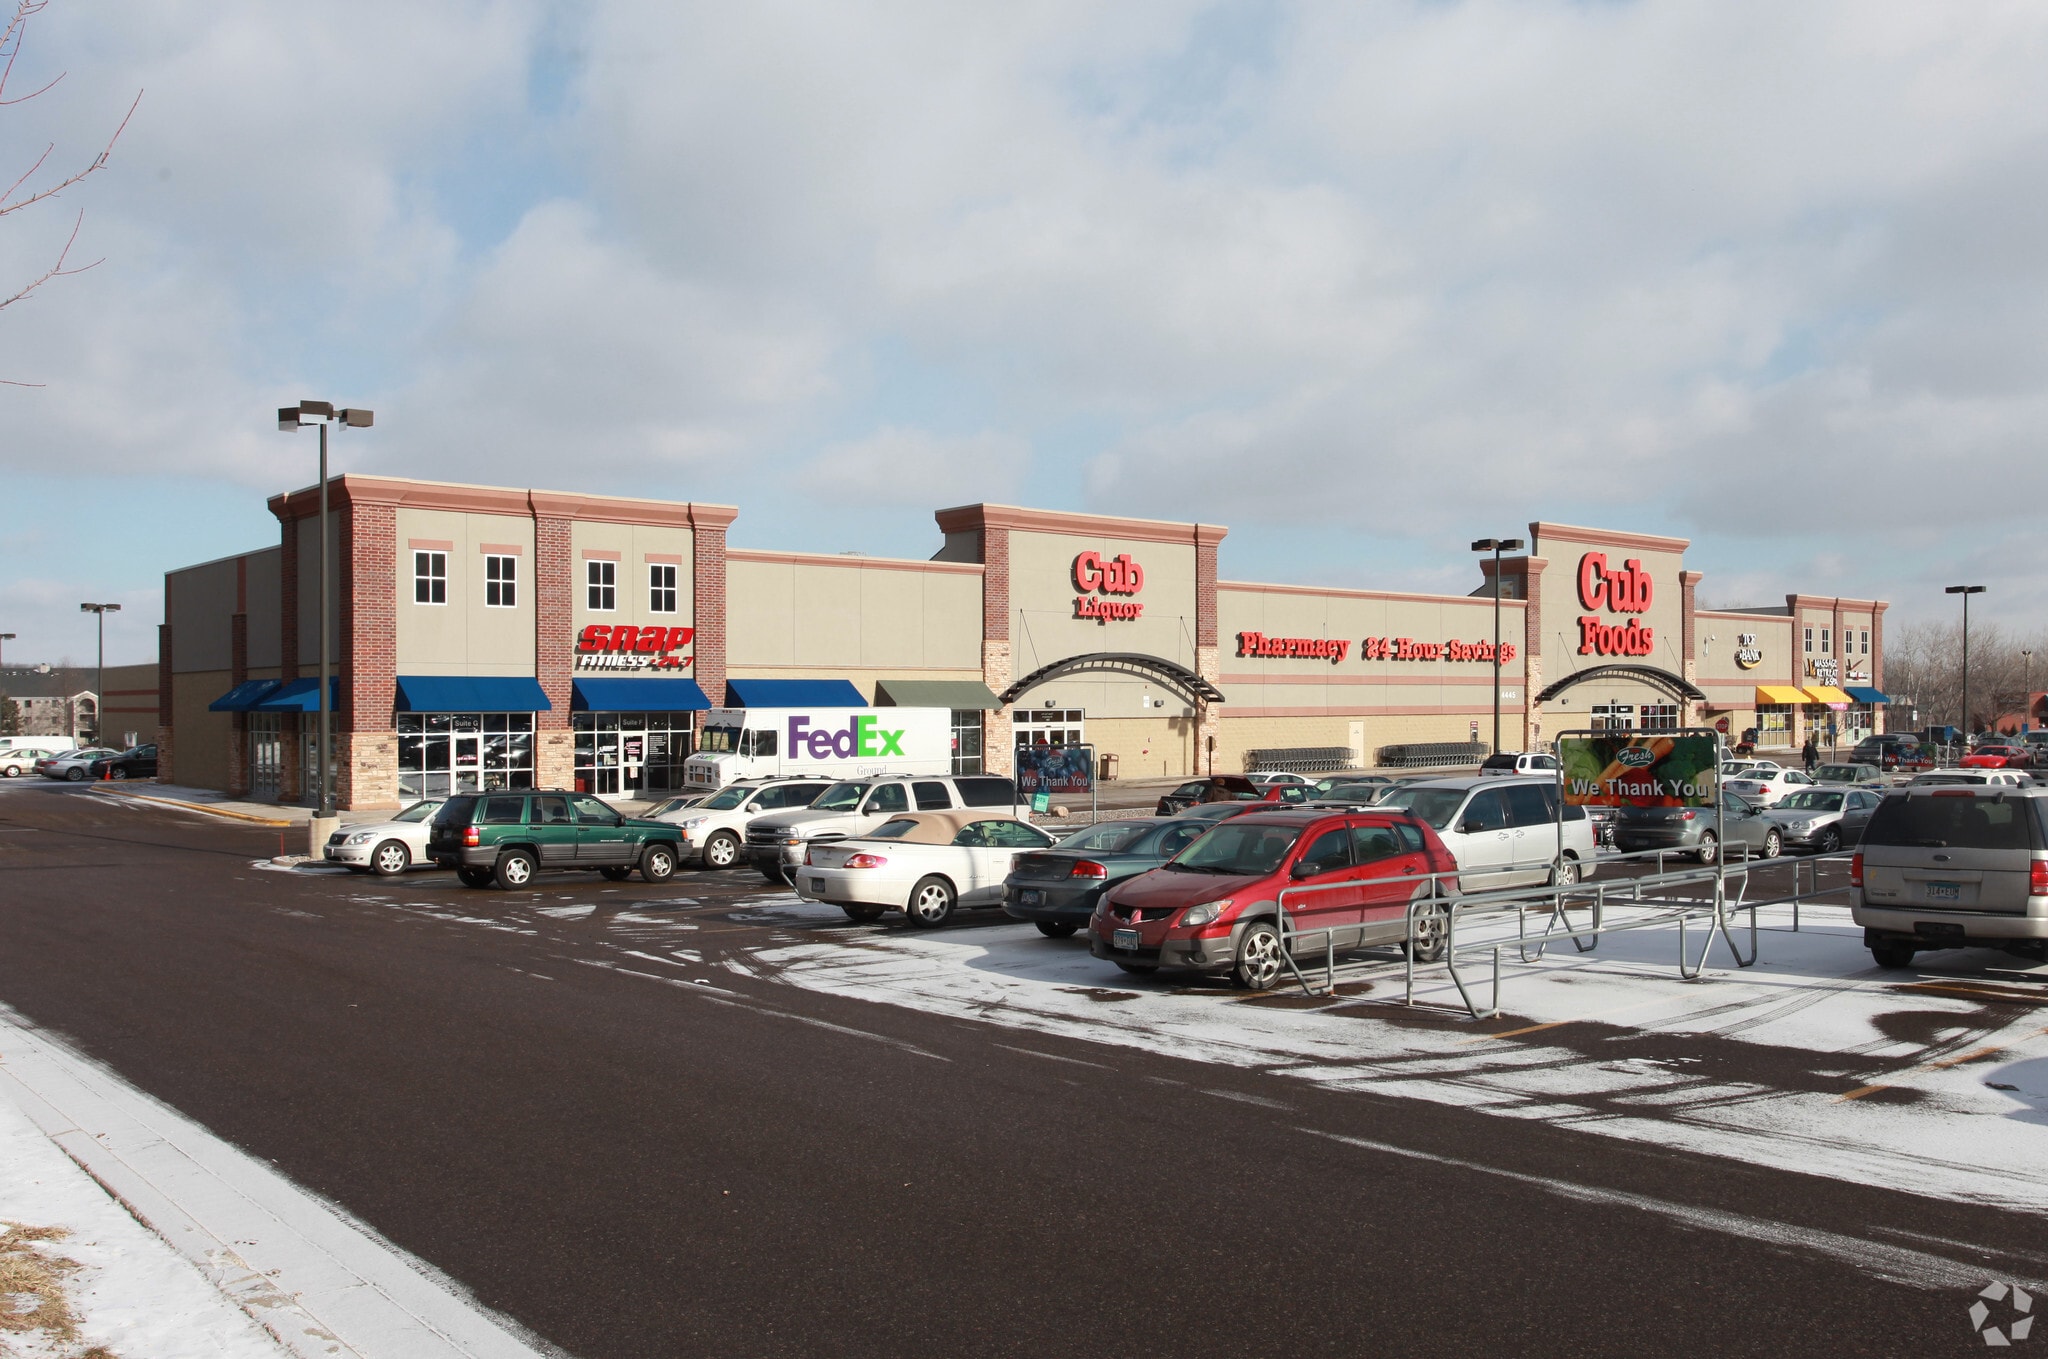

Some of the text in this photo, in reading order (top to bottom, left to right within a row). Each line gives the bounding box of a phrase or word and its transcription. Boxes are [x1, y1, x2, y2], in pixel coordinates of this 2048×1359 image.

[1077, 551, 1144, 593] Cub
[1581, 551, 1654, 612] Cub
[1077, 596, 1144, 622] Liquor
[1581, 616, 1654, 655] Foods
[1742, 633, 1757, 646] TCF
[1240, 632, 1351, 661] Pharmacy
[1367, 637, 1391, 658] 24
[1396, 638, 1446, 659] Hour
[1741, 649, 1760, 661] BANK
[788, 715, 906, 760] FedEx
[1619, 747, 1652, 764] Fresh
[1898, 756, 1919, 764] Thank
[856, 764, 887, 776] Ground
[1021, 776, 1088, 787] We Thank You
[1571, 778, 1710, 798] We Thank You
